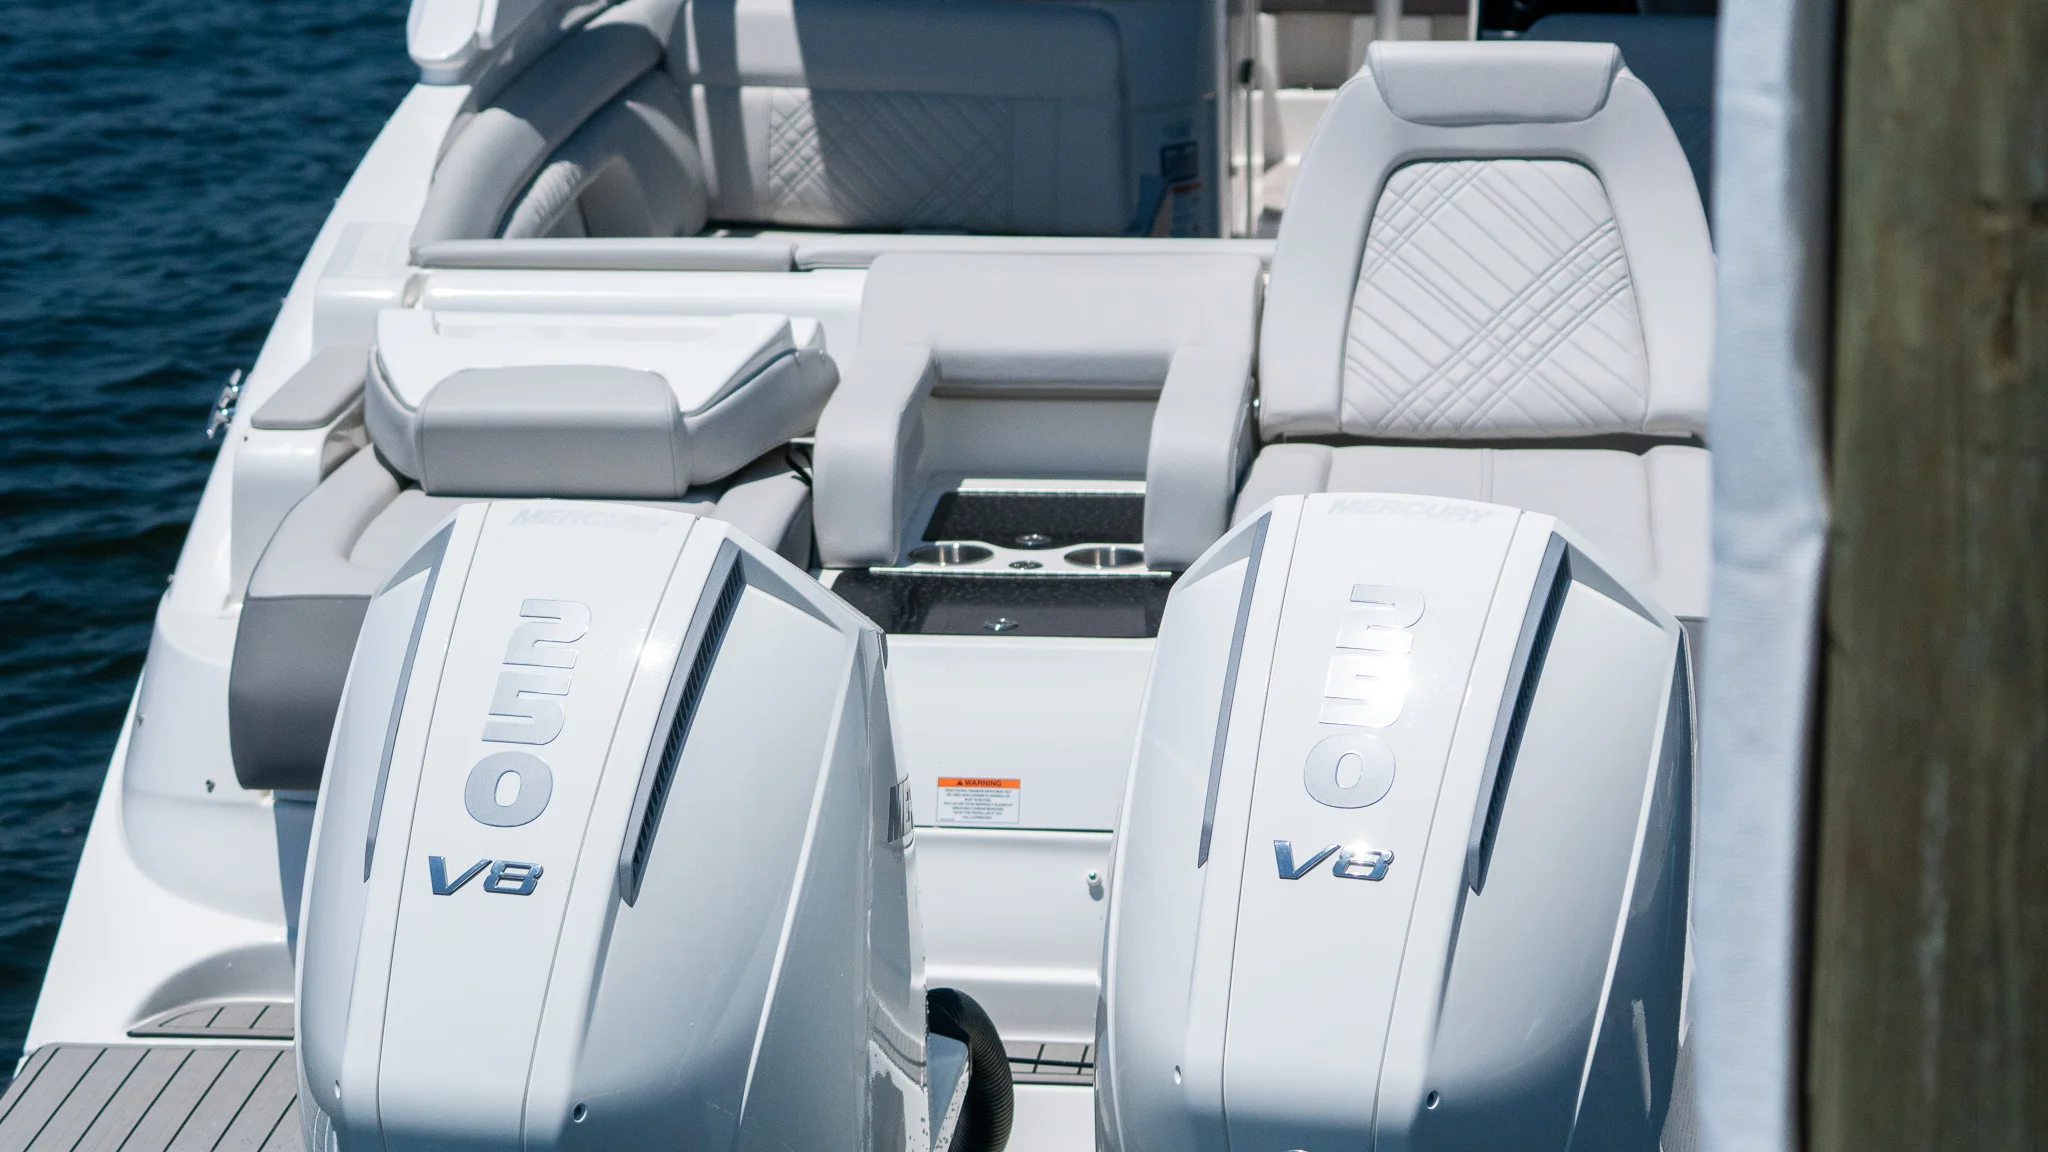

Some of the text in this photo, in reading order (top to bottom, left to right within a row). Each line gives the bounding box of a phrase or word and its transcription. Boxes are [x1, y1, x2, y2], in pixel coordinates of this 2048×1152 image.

[1327, 498, 1494, 524] MERCURY
[464, 597, 592, 828] 250
[1304, 583, 1425, 809] 250
[965, 779, 1002, 787] WARNING
[428, 855, 544, 896] V8
[1273, 839, 1395, 881] V8
